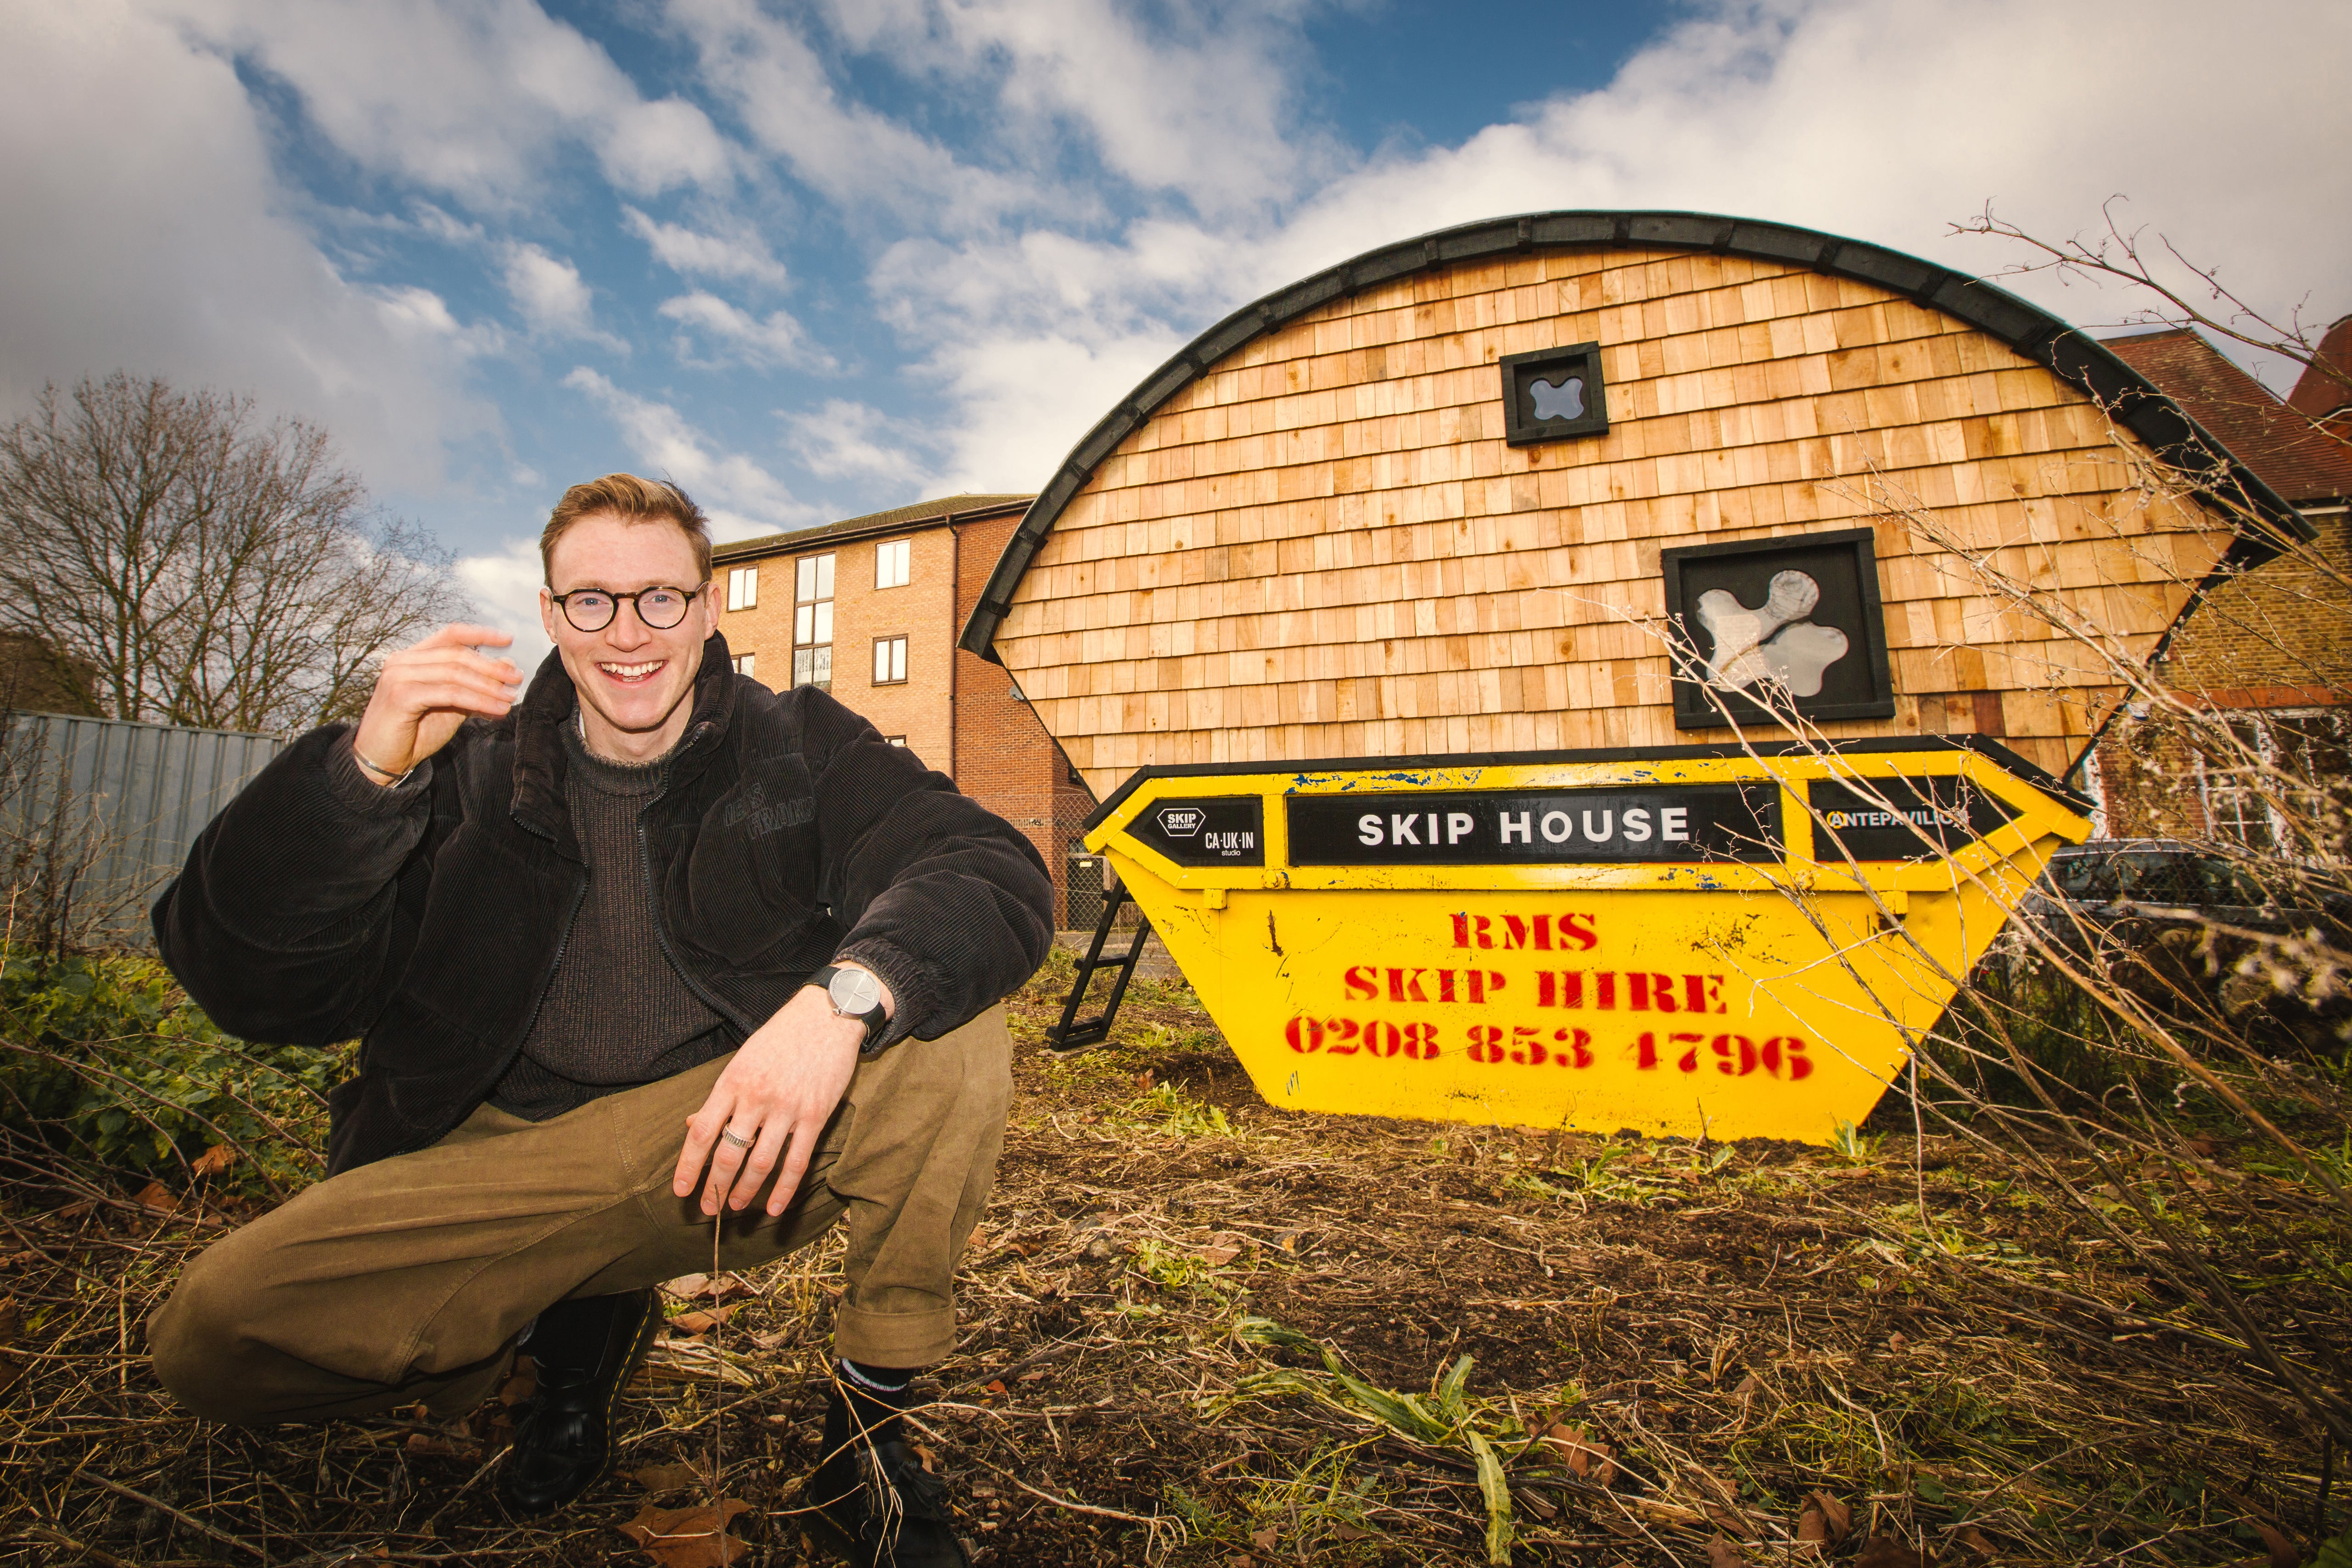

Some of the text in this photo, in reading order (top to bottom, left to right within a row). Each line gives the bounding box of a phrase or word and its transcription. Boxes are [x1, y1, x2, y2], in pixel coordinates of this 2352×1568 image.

[1167, 813, 1196, 823] SKIP
[1359, 807, 1689, 845] SKIP HOUSE
[1449, 913, 1597, 951] RMS
[1344, 966, 1726, 1014] SKIP HIRE
[1286, 1016, 1814, 1081] 0208 853 4796
